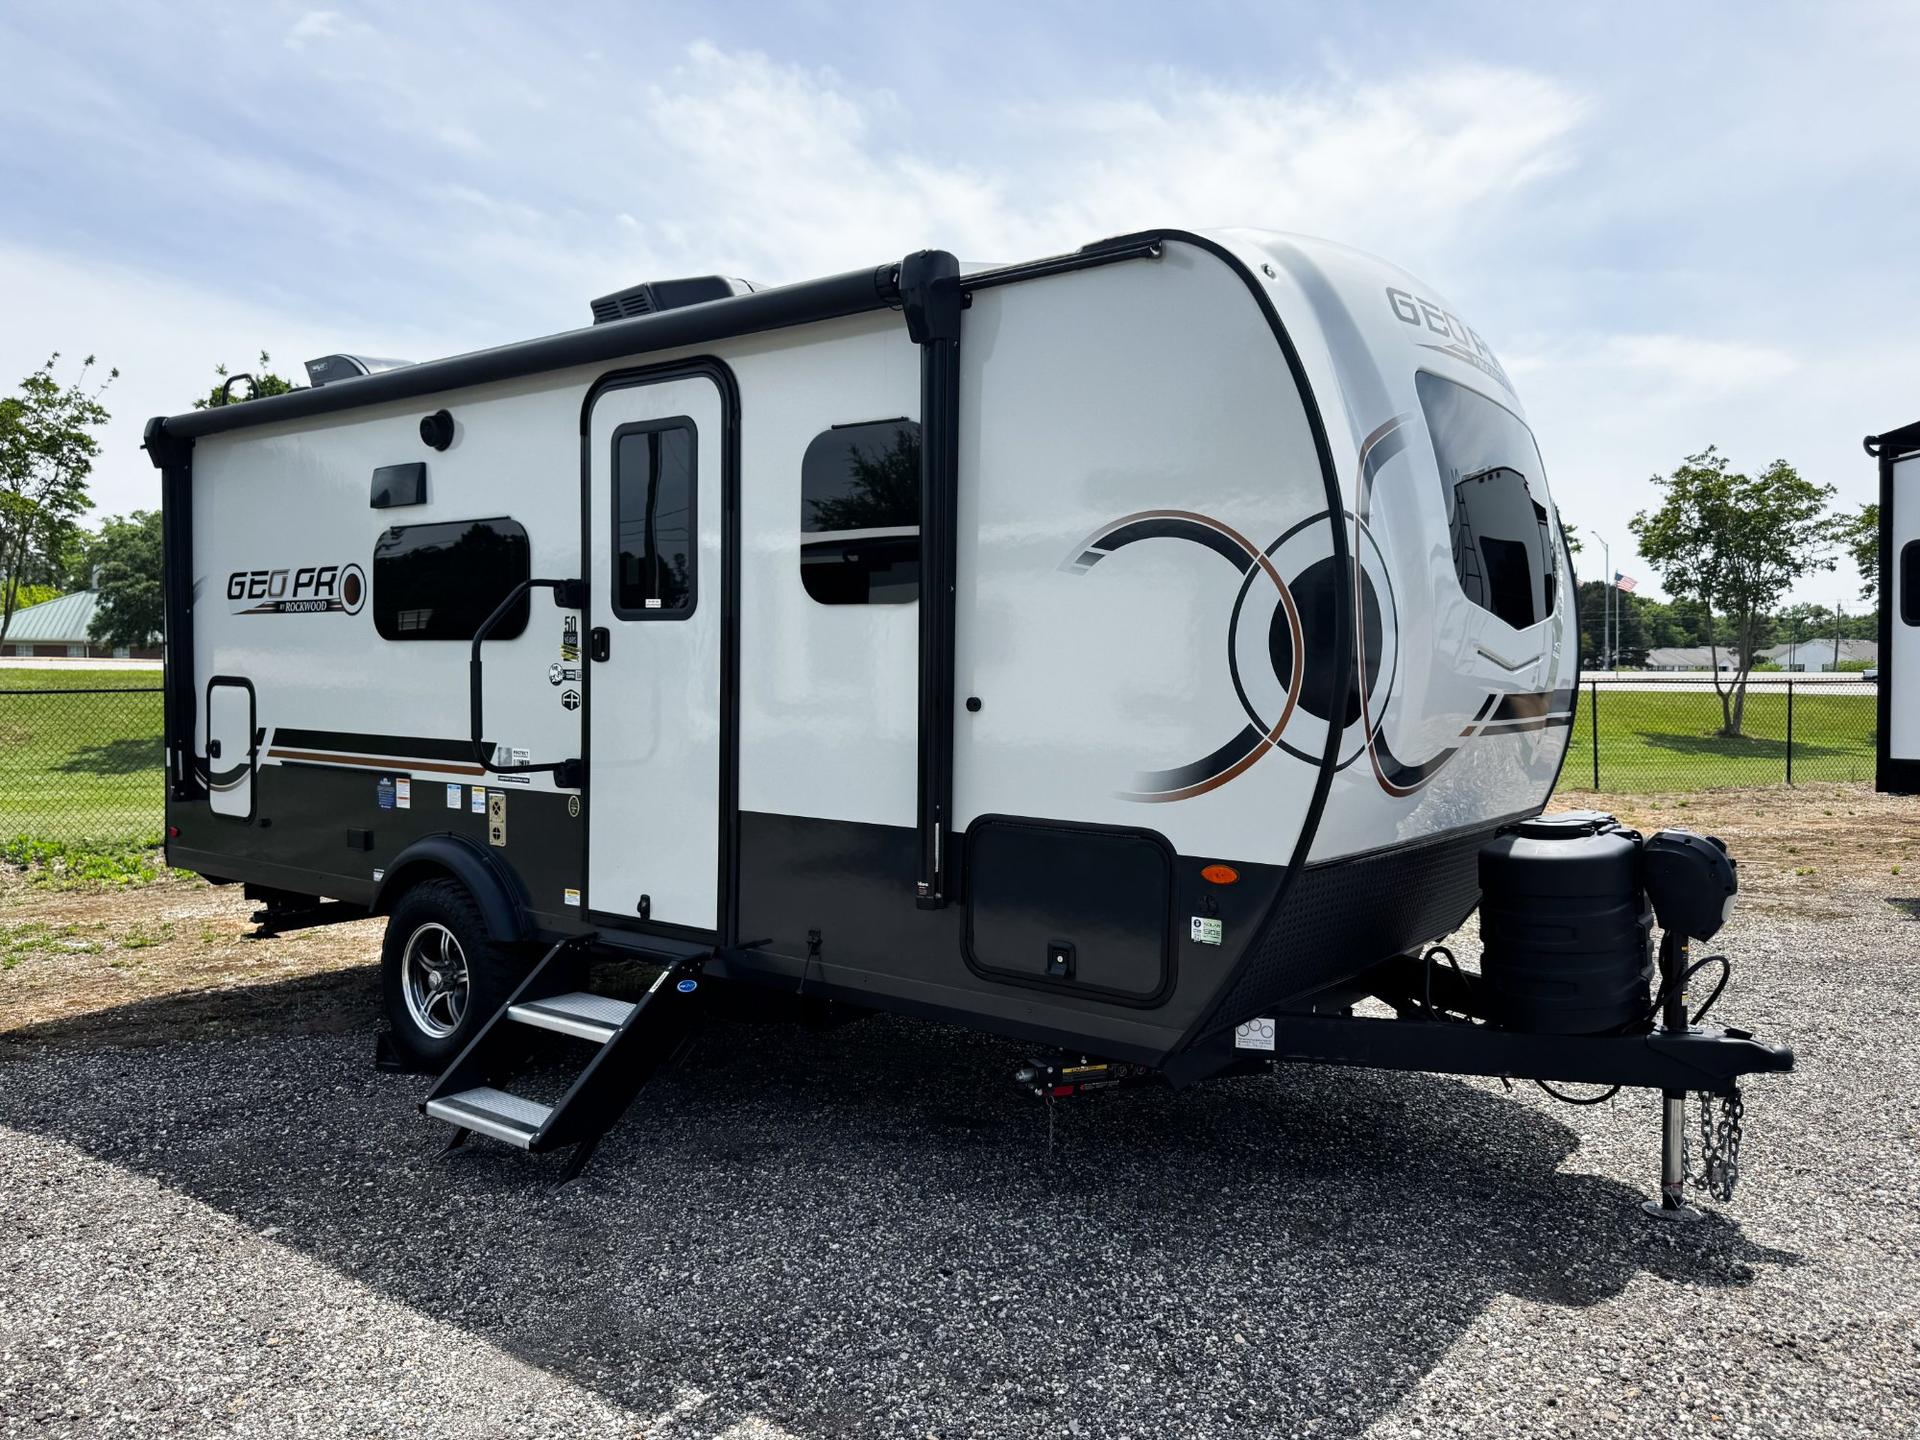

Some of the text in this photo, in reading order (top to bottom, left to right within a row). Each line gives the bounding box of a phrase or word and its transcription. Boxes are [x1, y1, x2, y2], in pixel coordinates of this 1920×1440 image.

[1386, 287, 1469, 347] GEO
[227, 569, 290, 600] GEO
[285, 600, 327, 612] ROCKWOOD
[564, 616, 576, 632] 50
